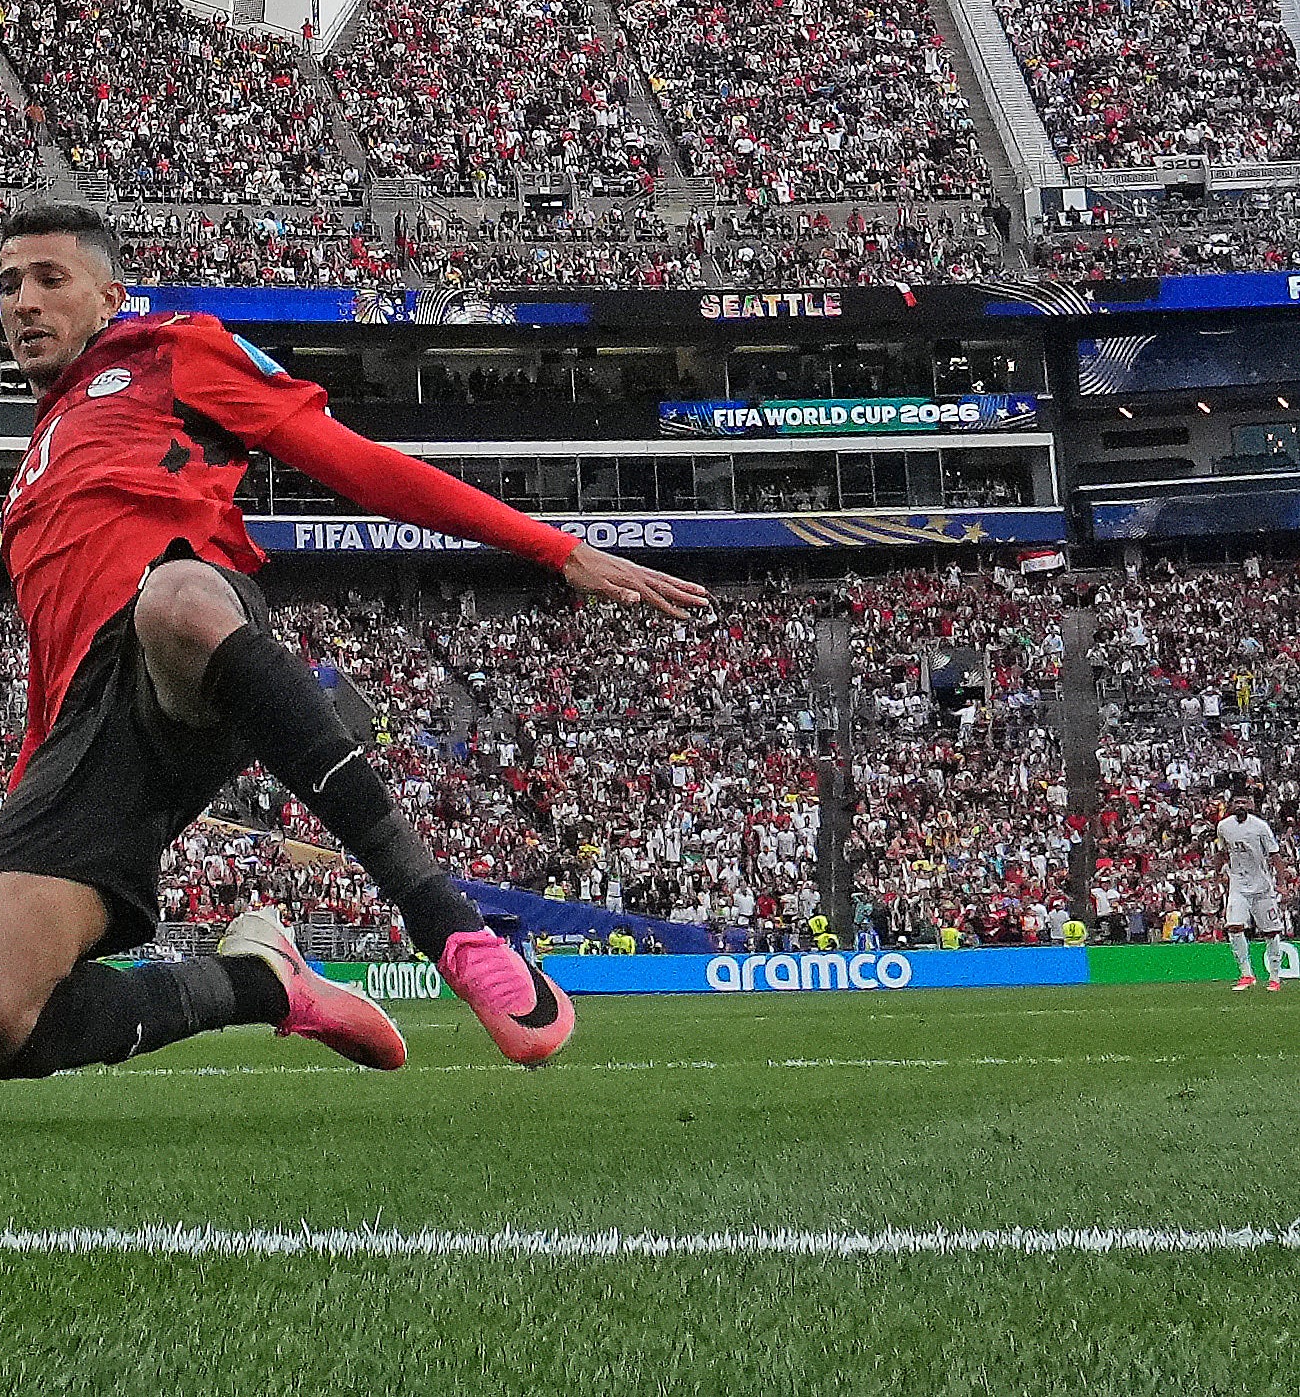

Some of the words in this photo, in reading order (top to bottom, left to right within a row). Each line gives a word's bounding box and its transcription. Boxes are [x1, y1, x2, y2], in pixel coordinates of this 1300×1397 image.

[1162, 159, 1201, 171] 320
[700, 291, 843, 319] SEATTLE
[713, 407, 764, 427] FIFA
[764, 406, 849, 426] WORLD
[850, 404, 899, 425] CUP
[900, 403, 981, 423] 2026
[295, 523, 366, 550] FIFA
[366, 962, 441, 1000] aramco
[706, 953, 913, 991] aramco
